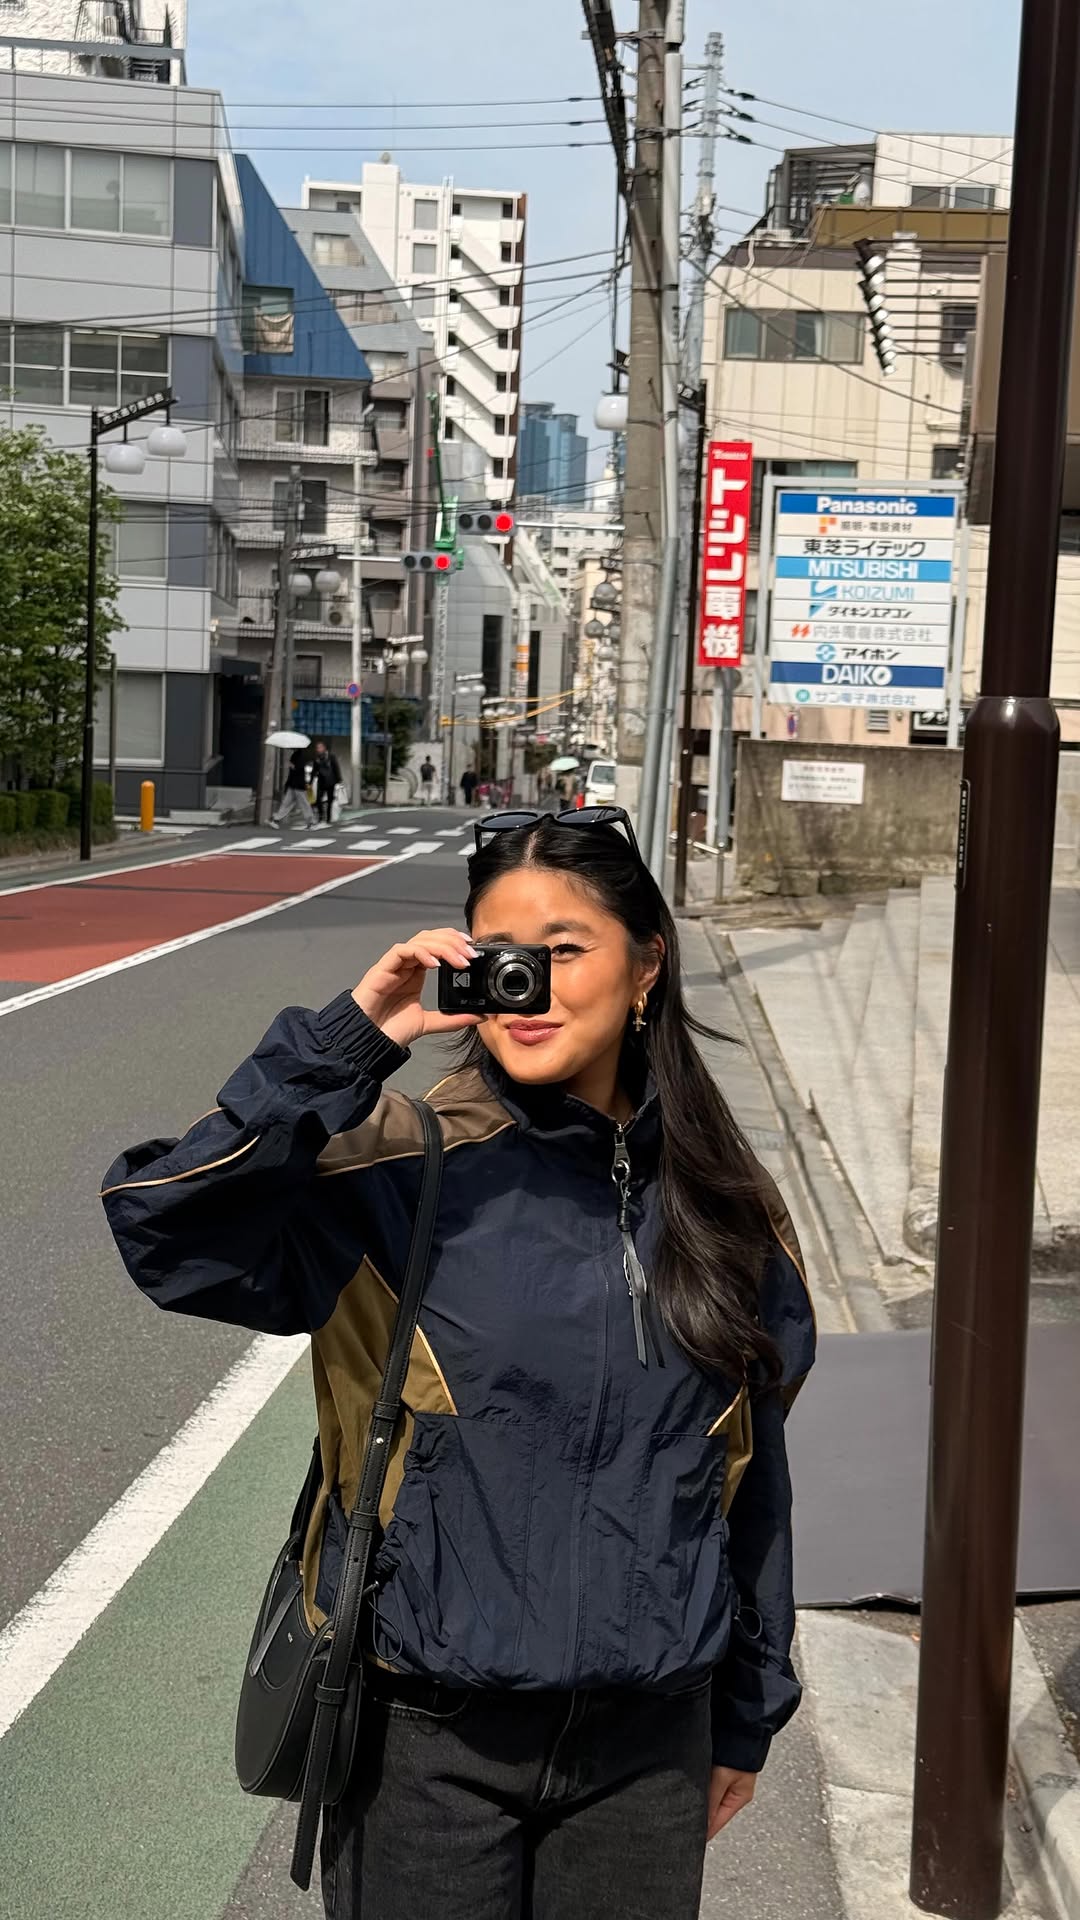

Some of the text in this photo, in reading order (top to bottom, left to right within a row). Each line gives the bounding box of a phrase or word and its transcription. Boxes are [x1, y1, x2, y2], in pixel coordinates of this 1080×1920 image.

[816, 495, 918, 515] Panasonic
[803, 538, 926, 558] 東芝ライテック
[702, 467, 749, 659] トシン電機
[808, 559, 920, 580] MITSUBISHI
[841, 585, 915, 601] KOIZUMI
[827, 605, 913, 619] ダイキンエアコン
[841, 647, 902, 661] アイホン
[821, 664, 893, 686] DAIKO
